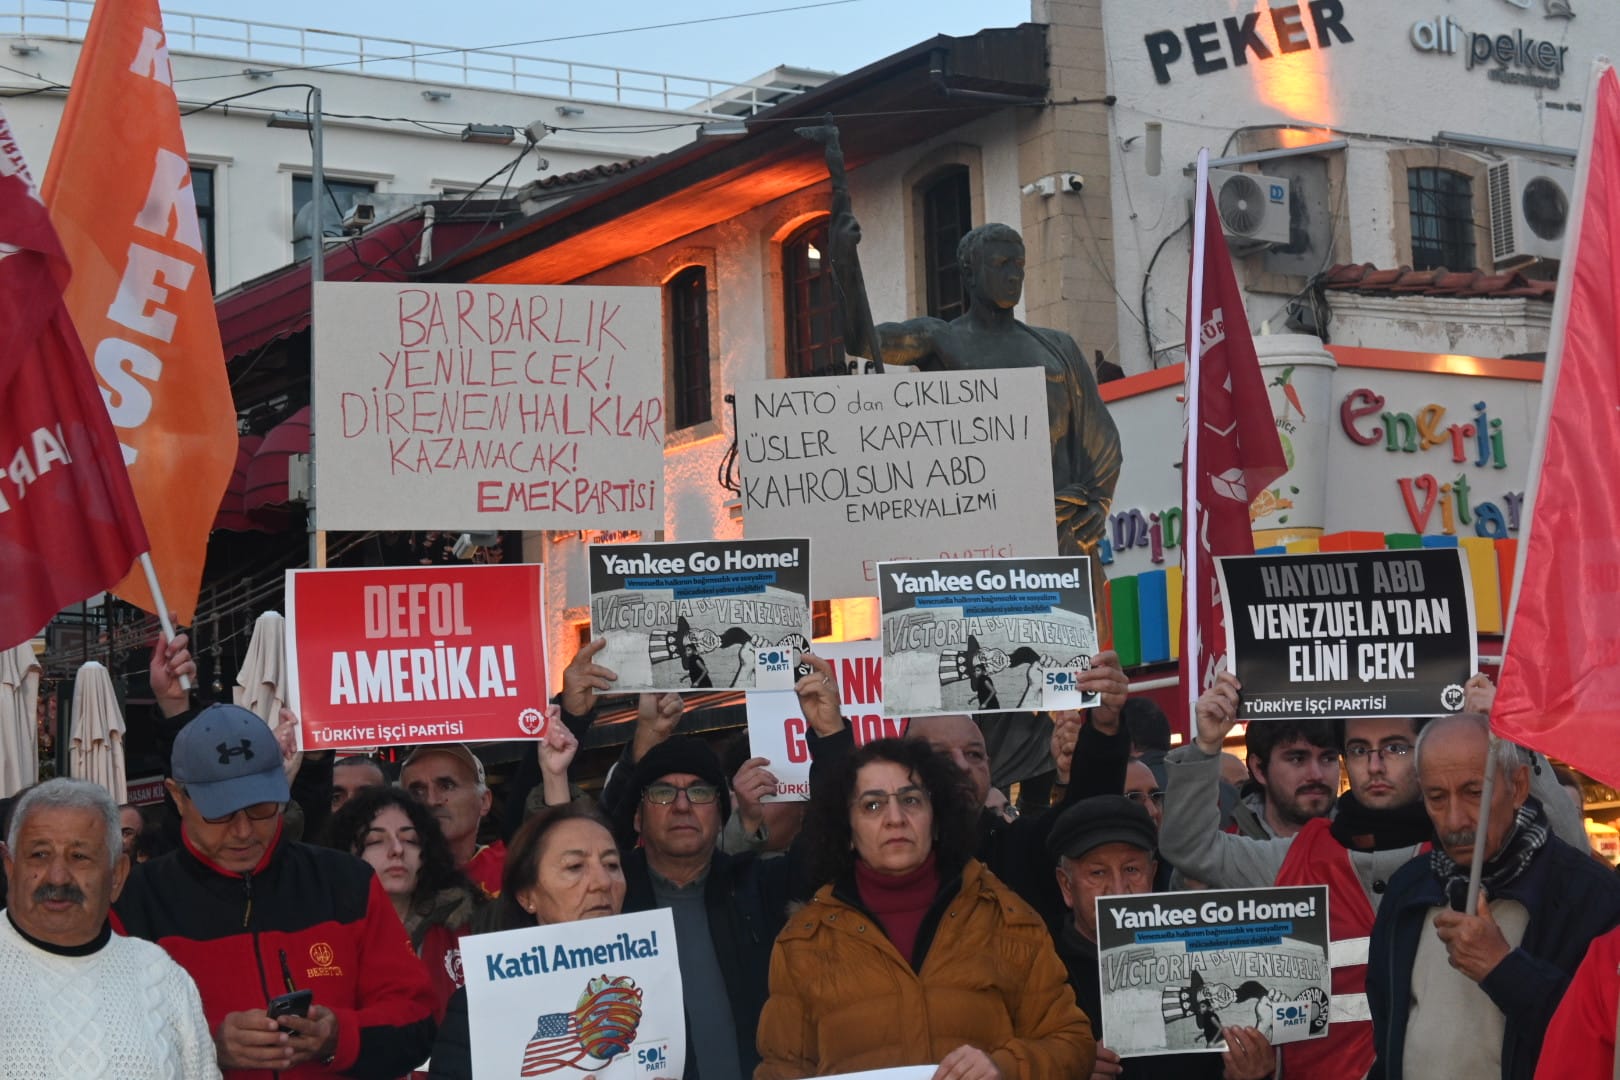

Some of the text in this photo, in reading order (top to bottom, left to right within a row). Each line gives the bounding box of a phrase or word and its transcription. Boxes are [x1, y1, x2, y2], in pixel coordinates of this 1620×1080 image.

[1144, 0, 1354, 84] PEKER
[1411, 15, 1569, 74] ali peker
[398, 289, 627, 351] BARBARLIK
[379, 344, 614, 391] YENİLECEK!
[390, 437, 578, 476] KAZANACAK!
[745, 429, 837, 463] ÜSLER
[744, 455, 987, 510] KAHROLSUN ABD
[847, 489, 996, 523] EMPERYALİZMİ
[601, 547, 800, 575] Yankee Go Home!
[890, 569, 973, 593] Yankee
[976, 570, 1007, 591] Go
[1010, 568, 1080, 590] Home!
[1260, 560, 1425, 598] HAYDUT ABD
[364, 582, 472, 639] DEFOL
[716, 599, 802, 627] VENEZUELA
[1248, 598, 1451, 640] VENEZUELA'DAN
[1004, 617, 1090, 648] VENEZUELA
[330, 640, 517, 705] AMERİKA!
[758, 651, 789, 665] SOL
[1289, 640, 1415, 683] ELİNİ ÇEK!
[1046, 672, 1076, 685] SOL
[1054, 684, 1077, 692] PART
[1245, 696, 1387, 714] TÜRKİYE İŞÇİ PARTİSİ
[312, 720, 464, 742] TÜRKİYE İŞÇİ PARTİSİ
[1110, 896, 1316, 929] Yankee Go Home!
[306, 966, 344, 978] BERETTA
[486, 931, 659, 981] Katil Amerika!
[1229, 951, 1321, 980] VENEZUELA
[1276, 1006, 1307, 1021] SOL
[638, 1048, 666, 1066] SOL
